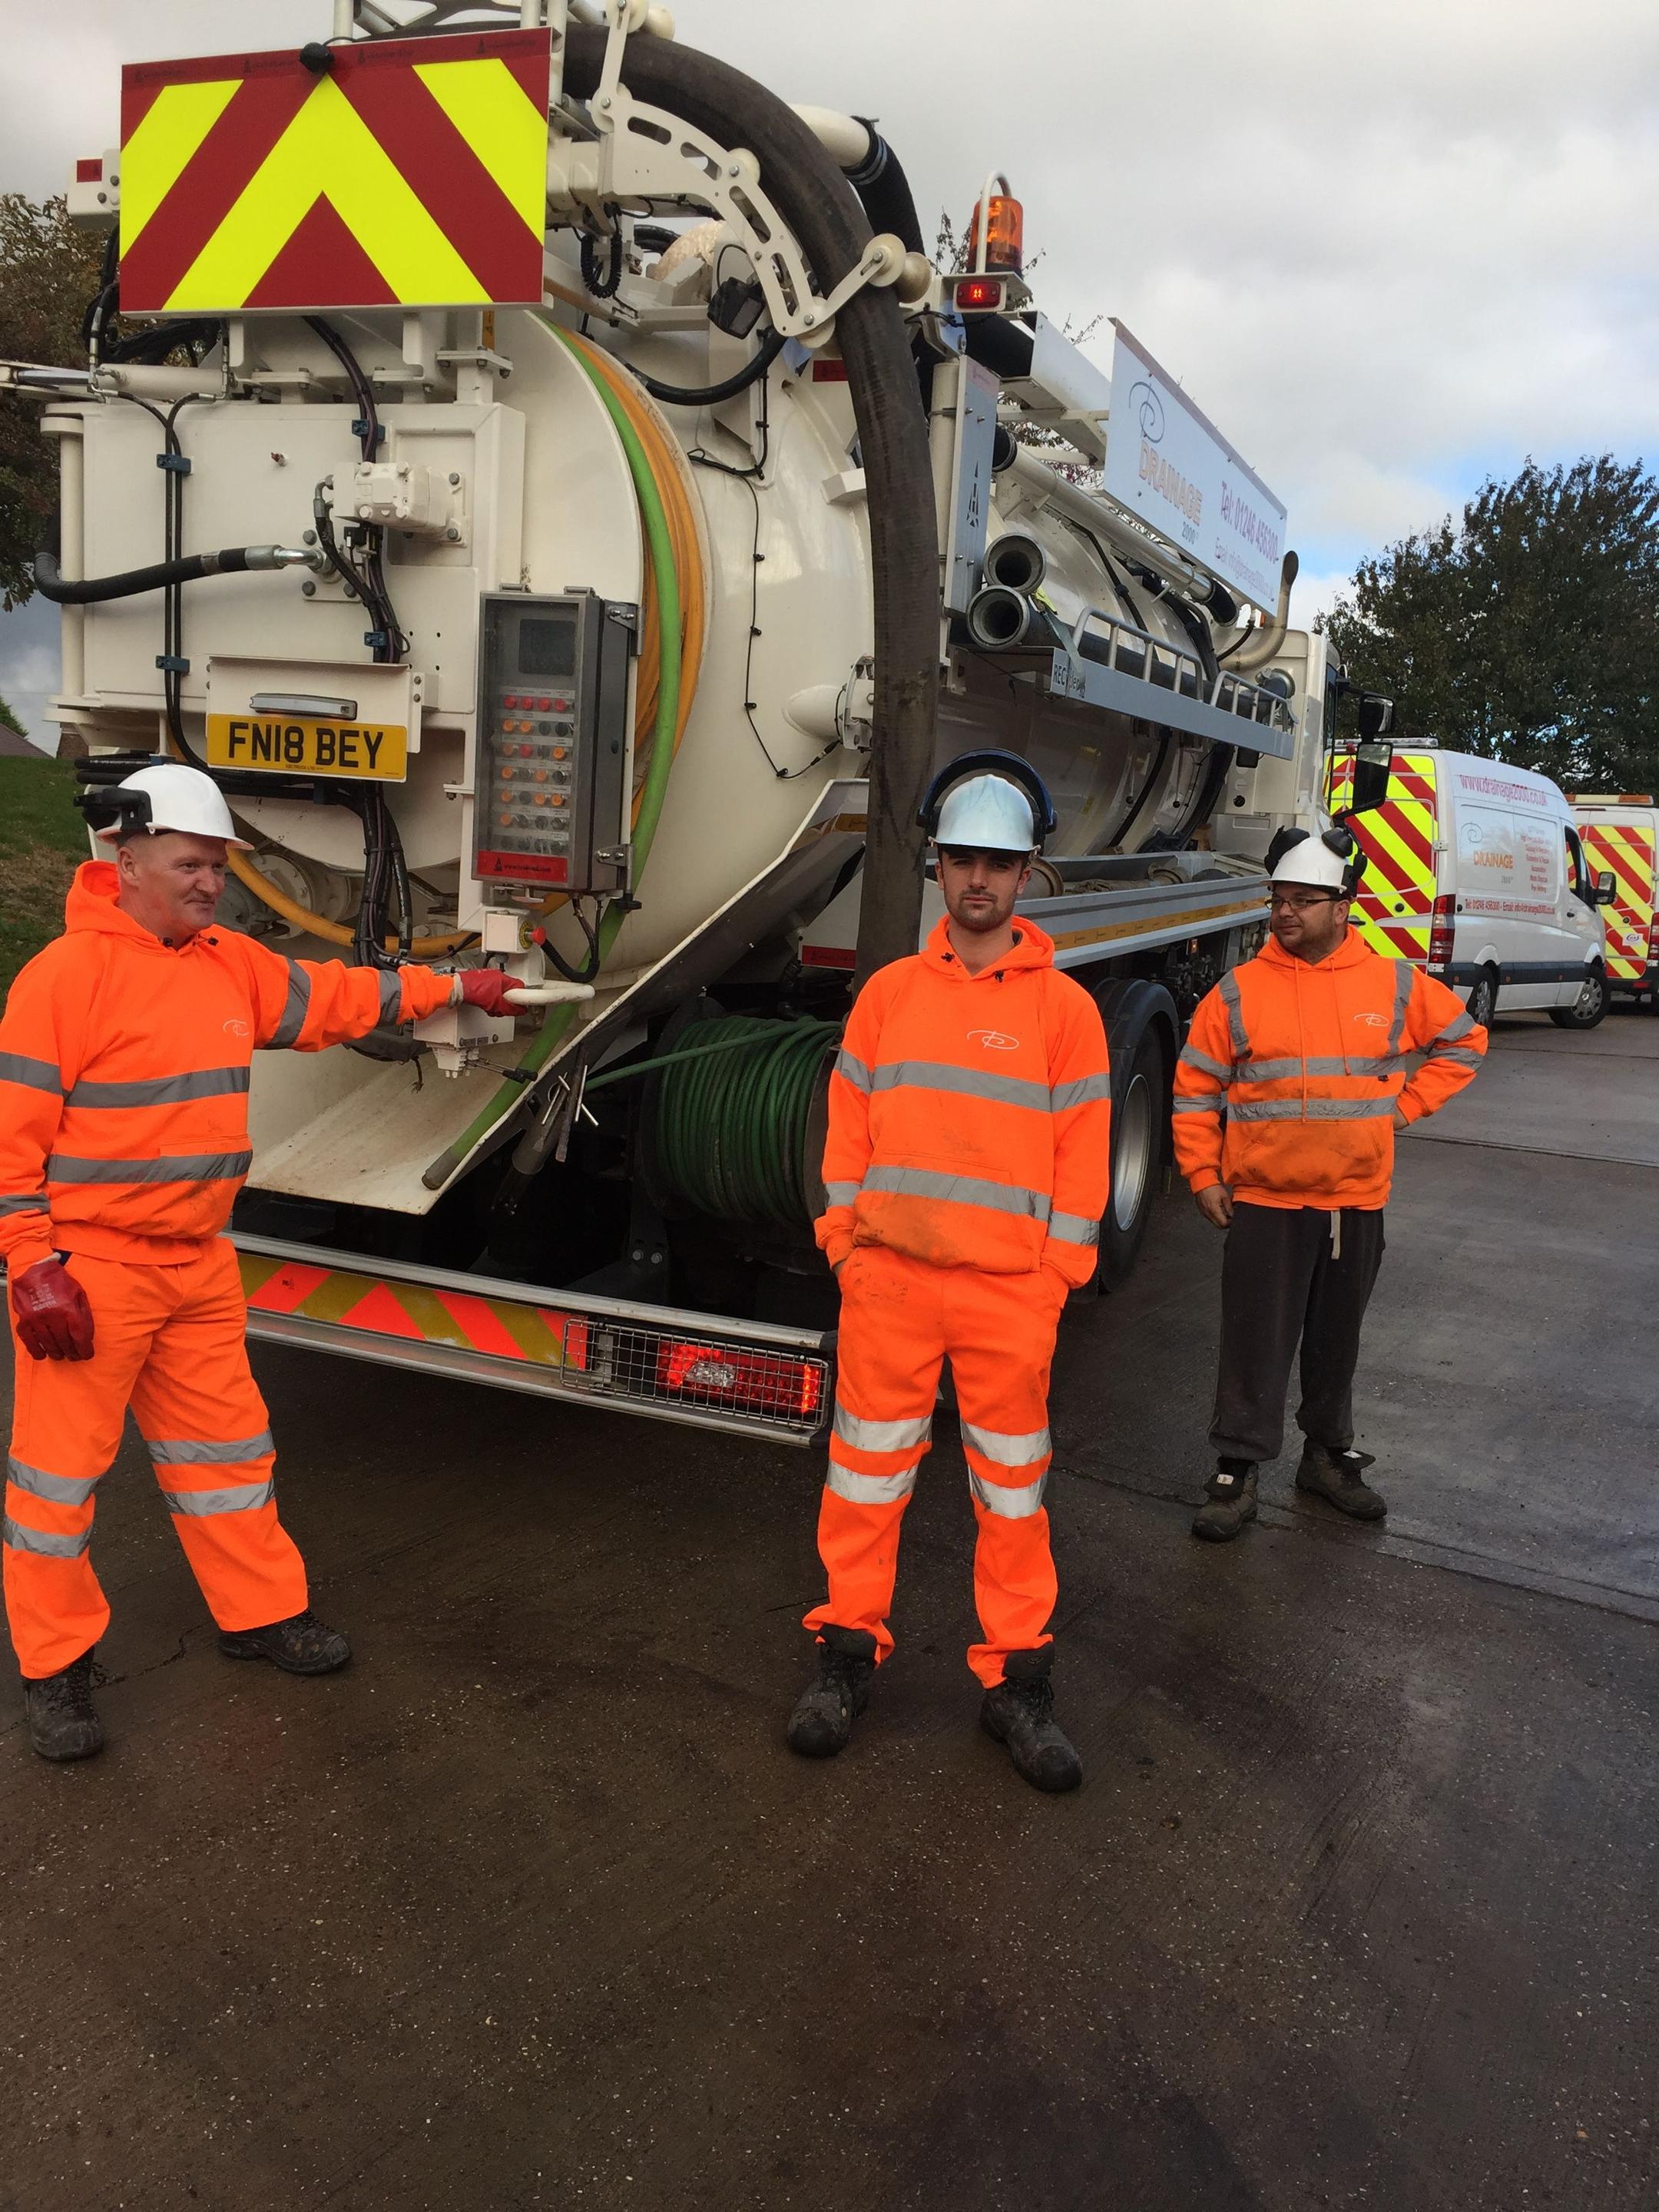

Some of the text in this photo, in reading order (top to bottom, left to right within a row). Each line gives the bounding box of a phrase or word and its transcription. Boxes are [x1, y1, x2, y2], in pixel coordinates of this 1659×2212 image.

[1139, 439, 1203, 527] DRAINAGE
[1221, 480, 1234, 525] Tel:
[1234, 497, 1256, 545] 01246
[228, 721, 383, 769] FN18 BEY
[1459, 774, 1548, 806] www.drainage2000.co.uk
[1474, 851, 1513, 869] DRAINAGE
